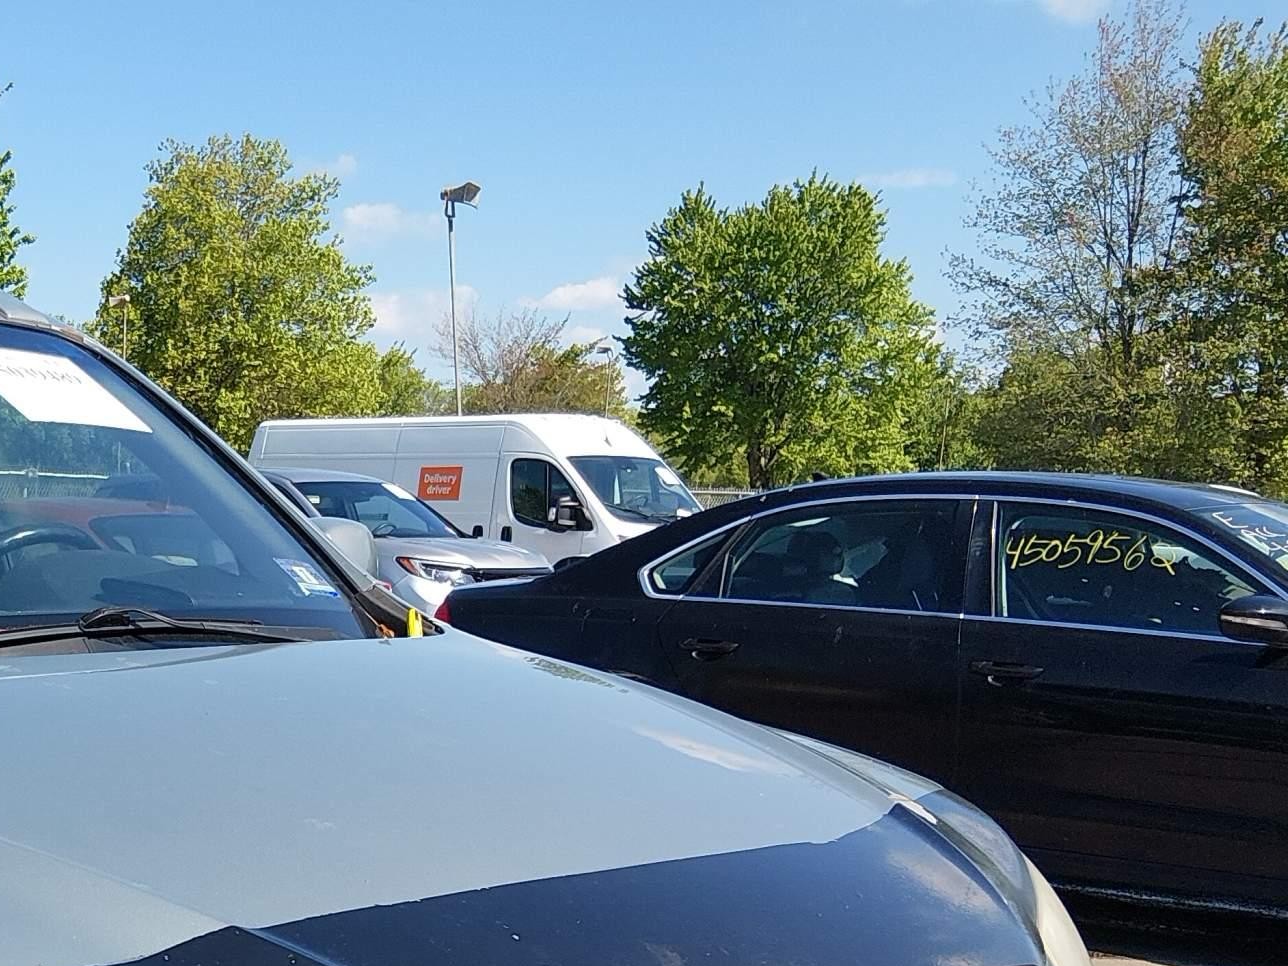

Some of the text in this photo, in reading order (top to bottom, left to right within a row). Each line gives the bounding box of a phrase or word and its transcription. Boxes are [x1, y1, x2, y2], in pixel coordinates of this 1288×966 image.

[423, 473, 457, 485] Delivery
[426, 484, 452, 495] driver
[1006, 529, 1176, 576] 45059562
